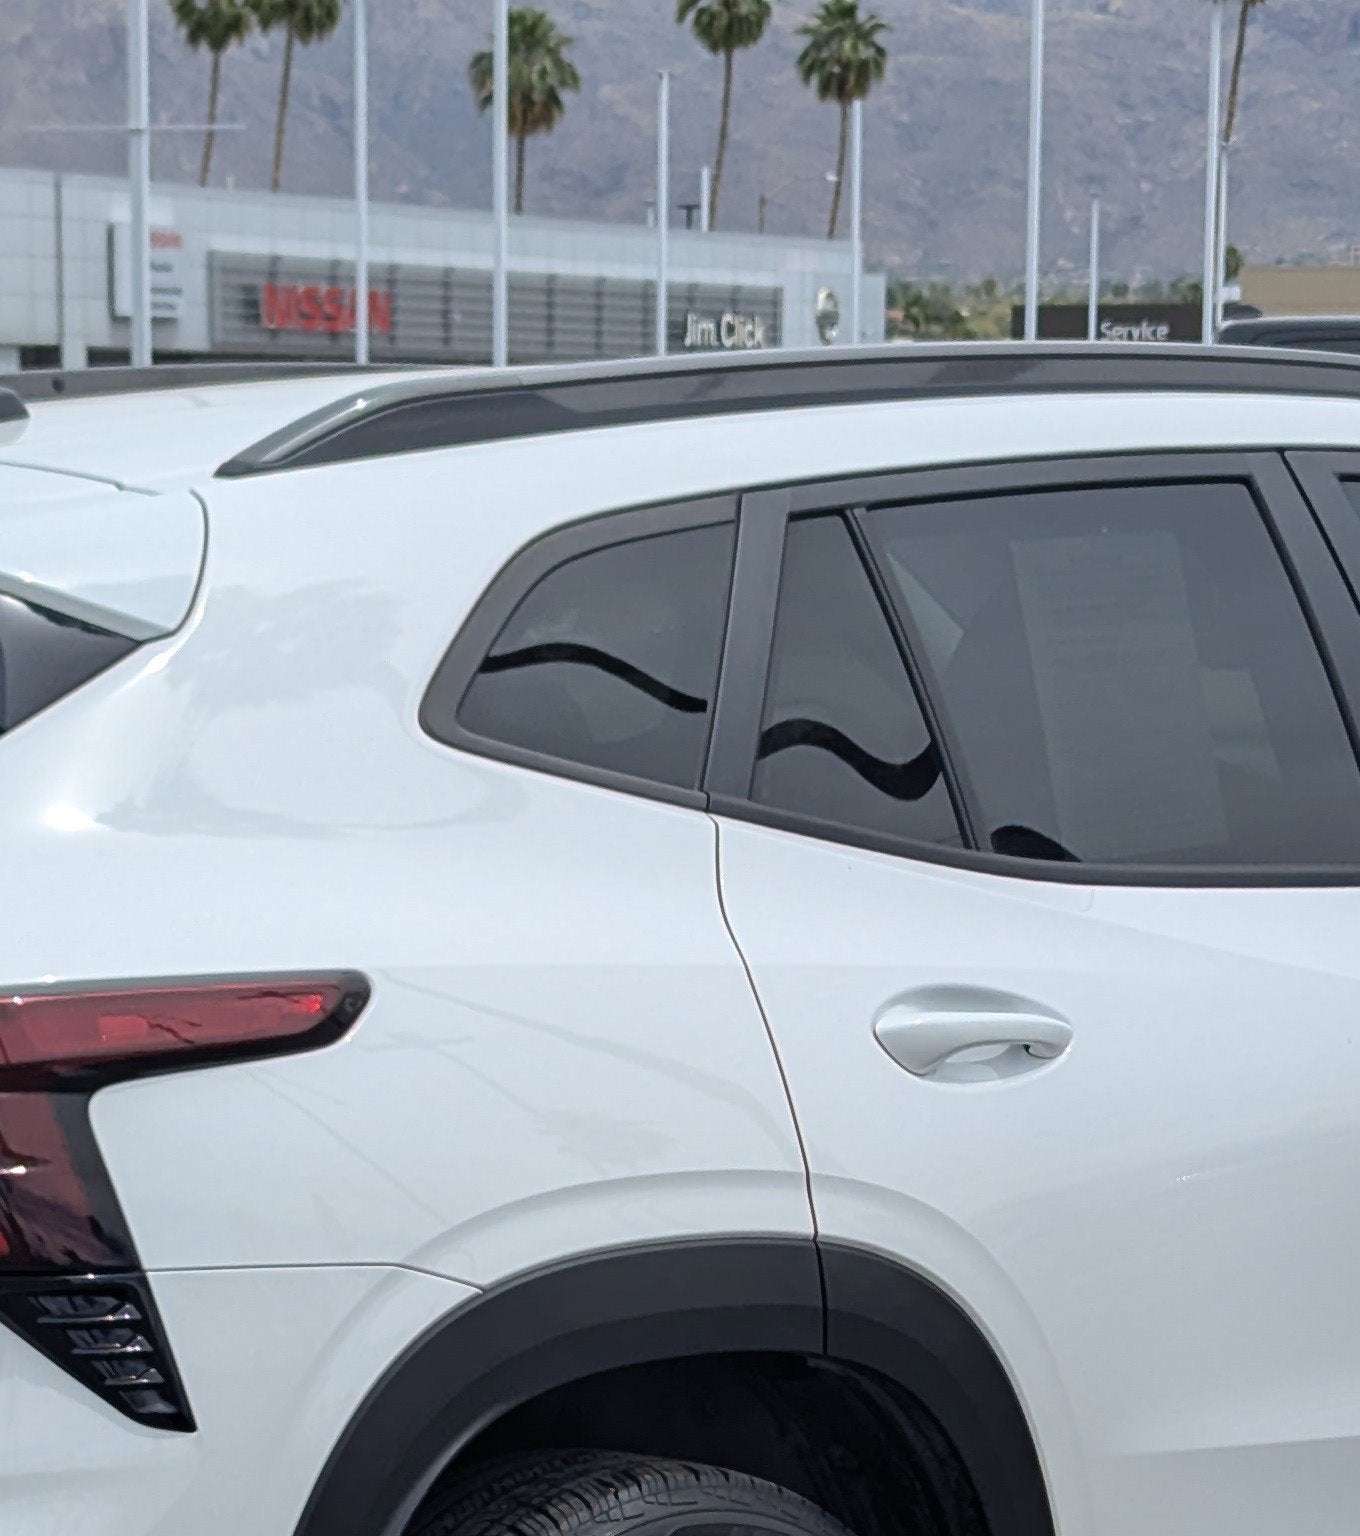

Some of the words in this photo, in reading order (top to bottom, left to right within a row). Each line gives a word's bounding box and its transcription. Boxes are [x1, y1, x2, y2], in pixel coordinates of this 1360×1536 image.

[685, 312, 720, 347] Jim
[721, 311, 766, 348] Click
[1100, 319, 1170, 341] Service
